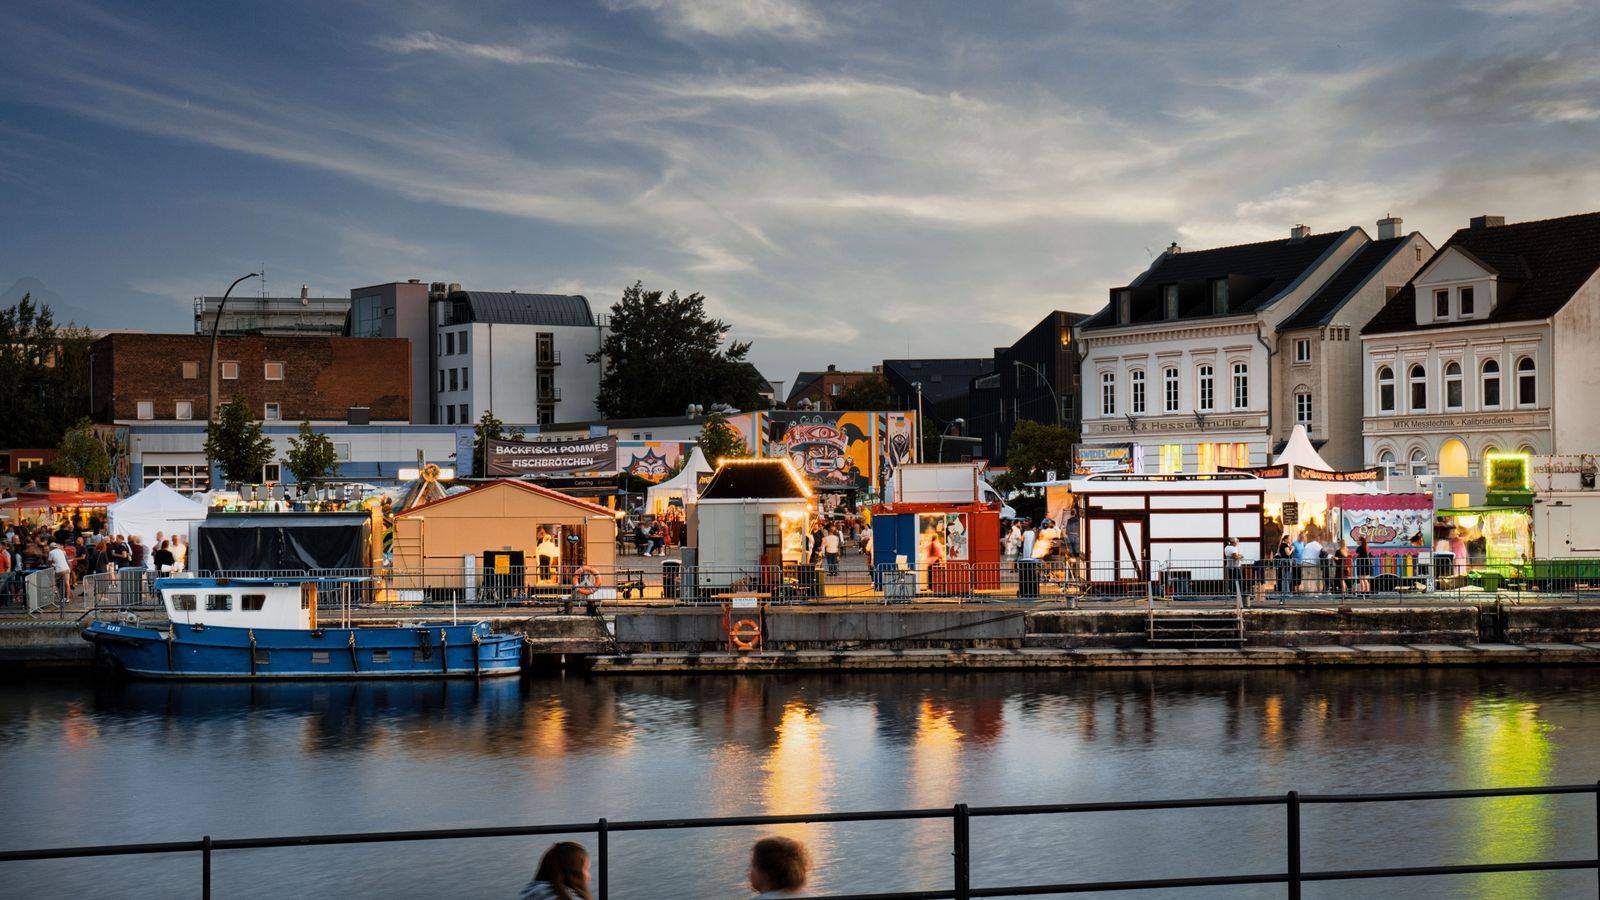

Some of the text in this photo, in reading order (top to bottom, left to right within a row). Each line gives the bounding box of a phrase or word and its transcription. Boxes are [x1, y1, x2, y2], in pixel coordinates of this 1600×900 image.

[1103, 423, 1138, 431] Renc
[1393, 420, 1409, 428] MTK
[1411, 419, 1455, 427] Messtechnik
[1461, 417, 1514, 426] Kalibrierdienst
[496, 443, 609, 454] BACKFISCH POMMES
[512, 457, 594, 467] FISCHBRÖTCHEN
